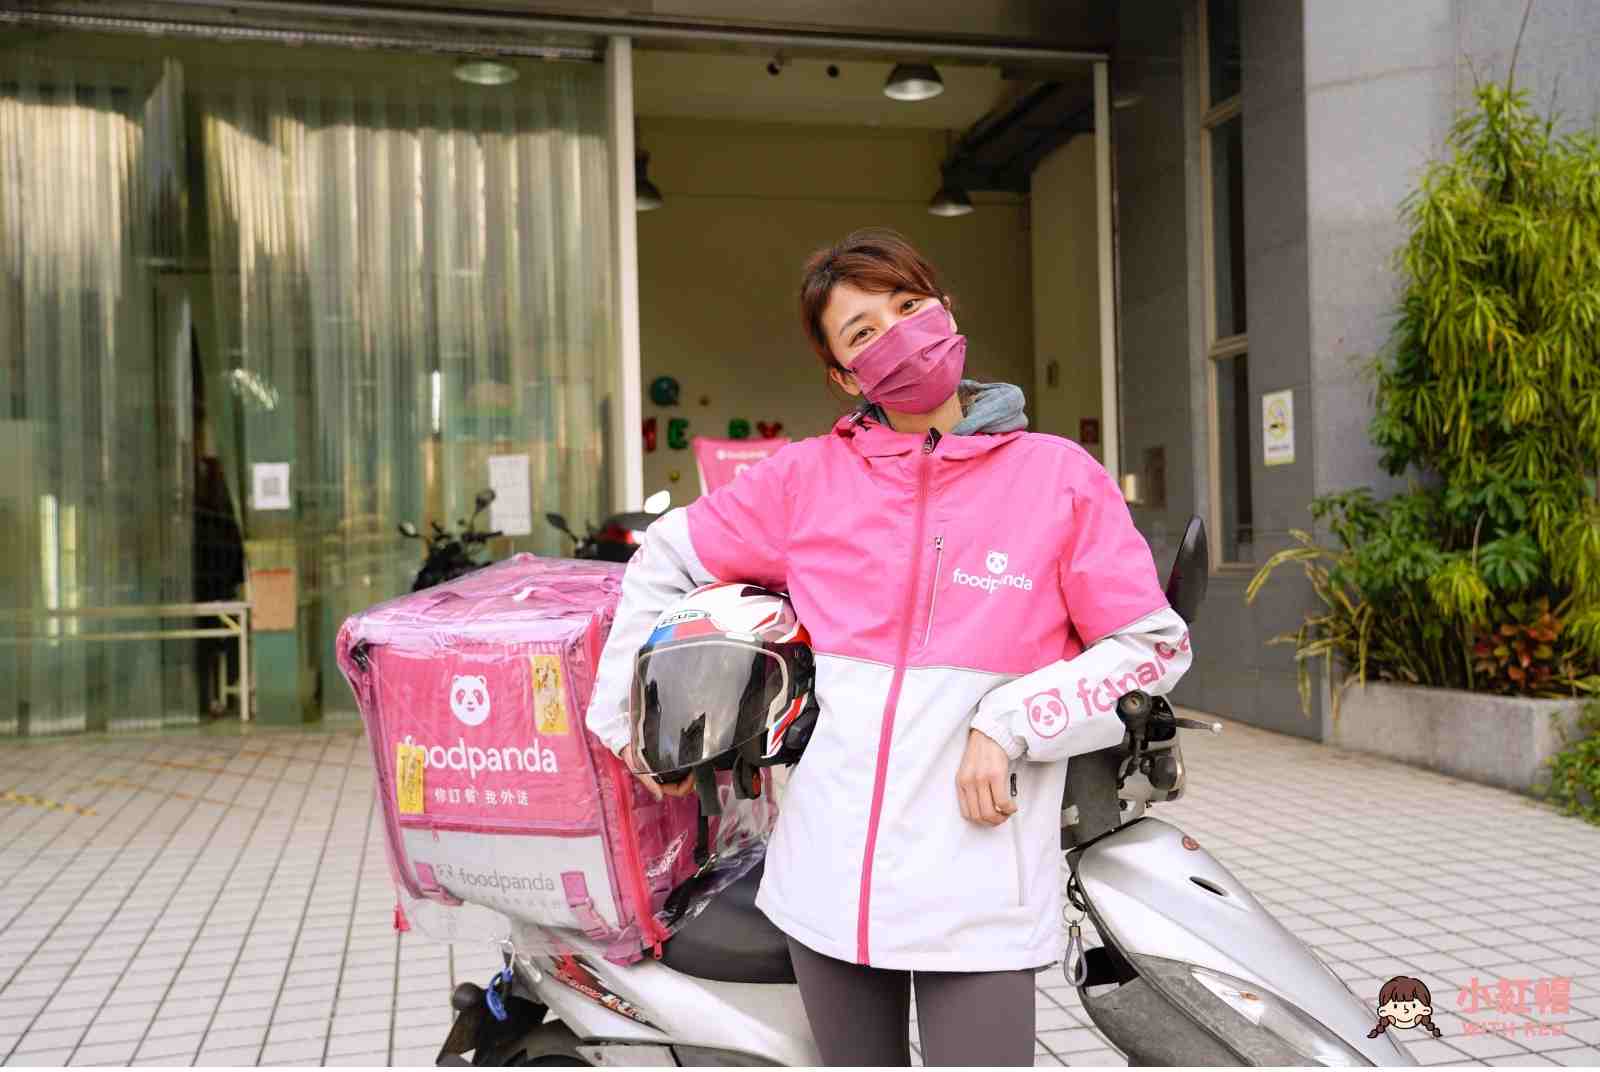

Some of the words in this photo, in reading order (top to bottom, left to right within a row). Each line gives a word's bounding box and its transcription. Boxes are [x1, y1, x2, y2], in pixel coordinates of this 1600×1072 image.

[953, 567, 1033, 594] foodpnda
[404, 735, 559, 779] odpanda
[458, 868, 555, 893] foodpanda
